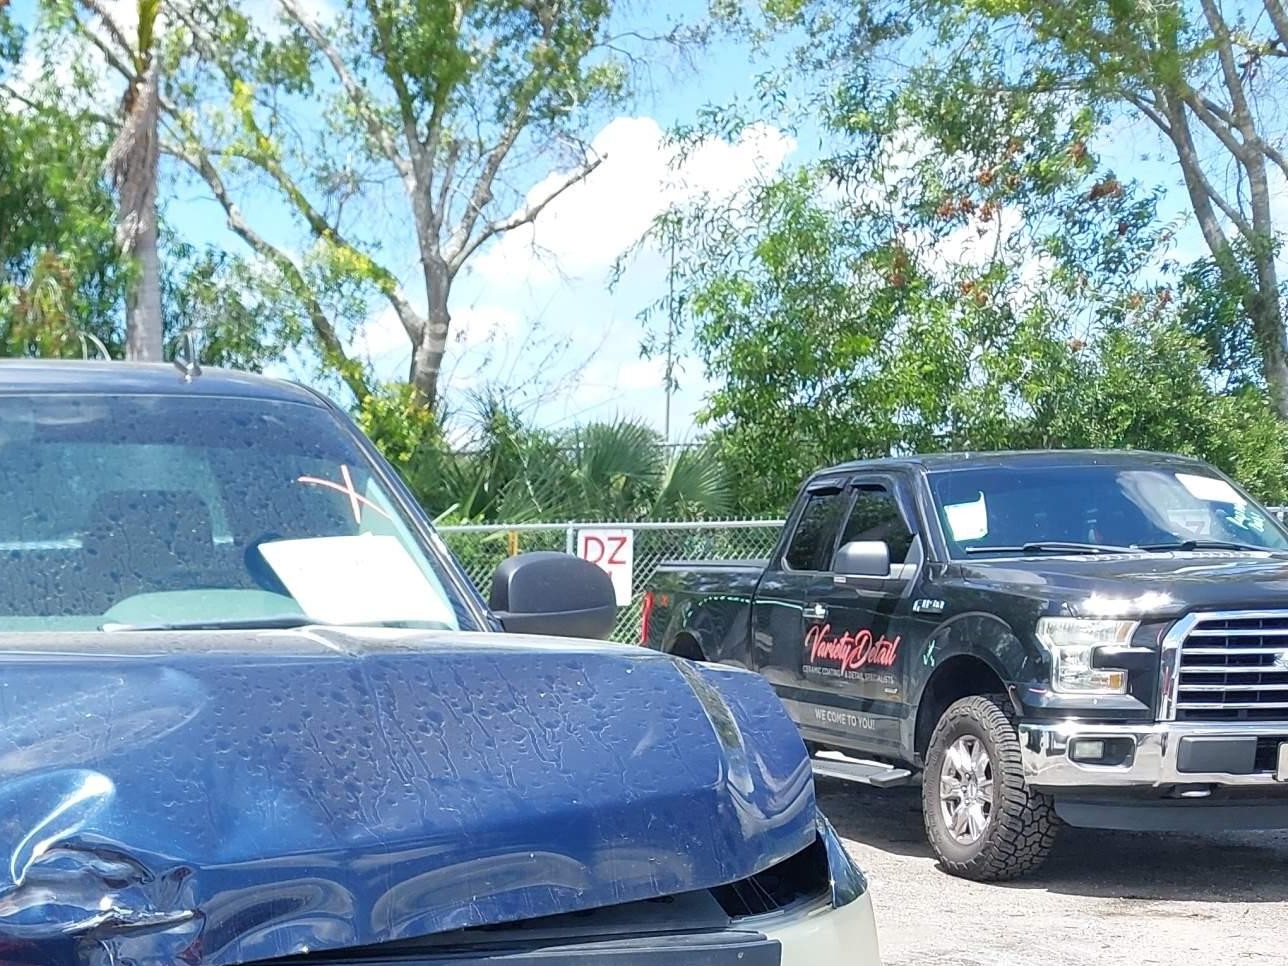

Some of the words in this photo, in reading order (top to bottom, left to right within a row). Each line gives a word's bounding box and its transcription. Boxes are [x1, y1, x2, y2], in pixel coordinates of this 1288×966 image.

[584, 536, 627, 566] DZ
[804, 623, 854, 676] Variety
[848, 629, 901, 669] Detail
[815, 708, 826, 721] WE
[827, 710, 846, 725] COME
[846, 713, 857, 727] TO
[857, 716, 875, 730] YOU!
